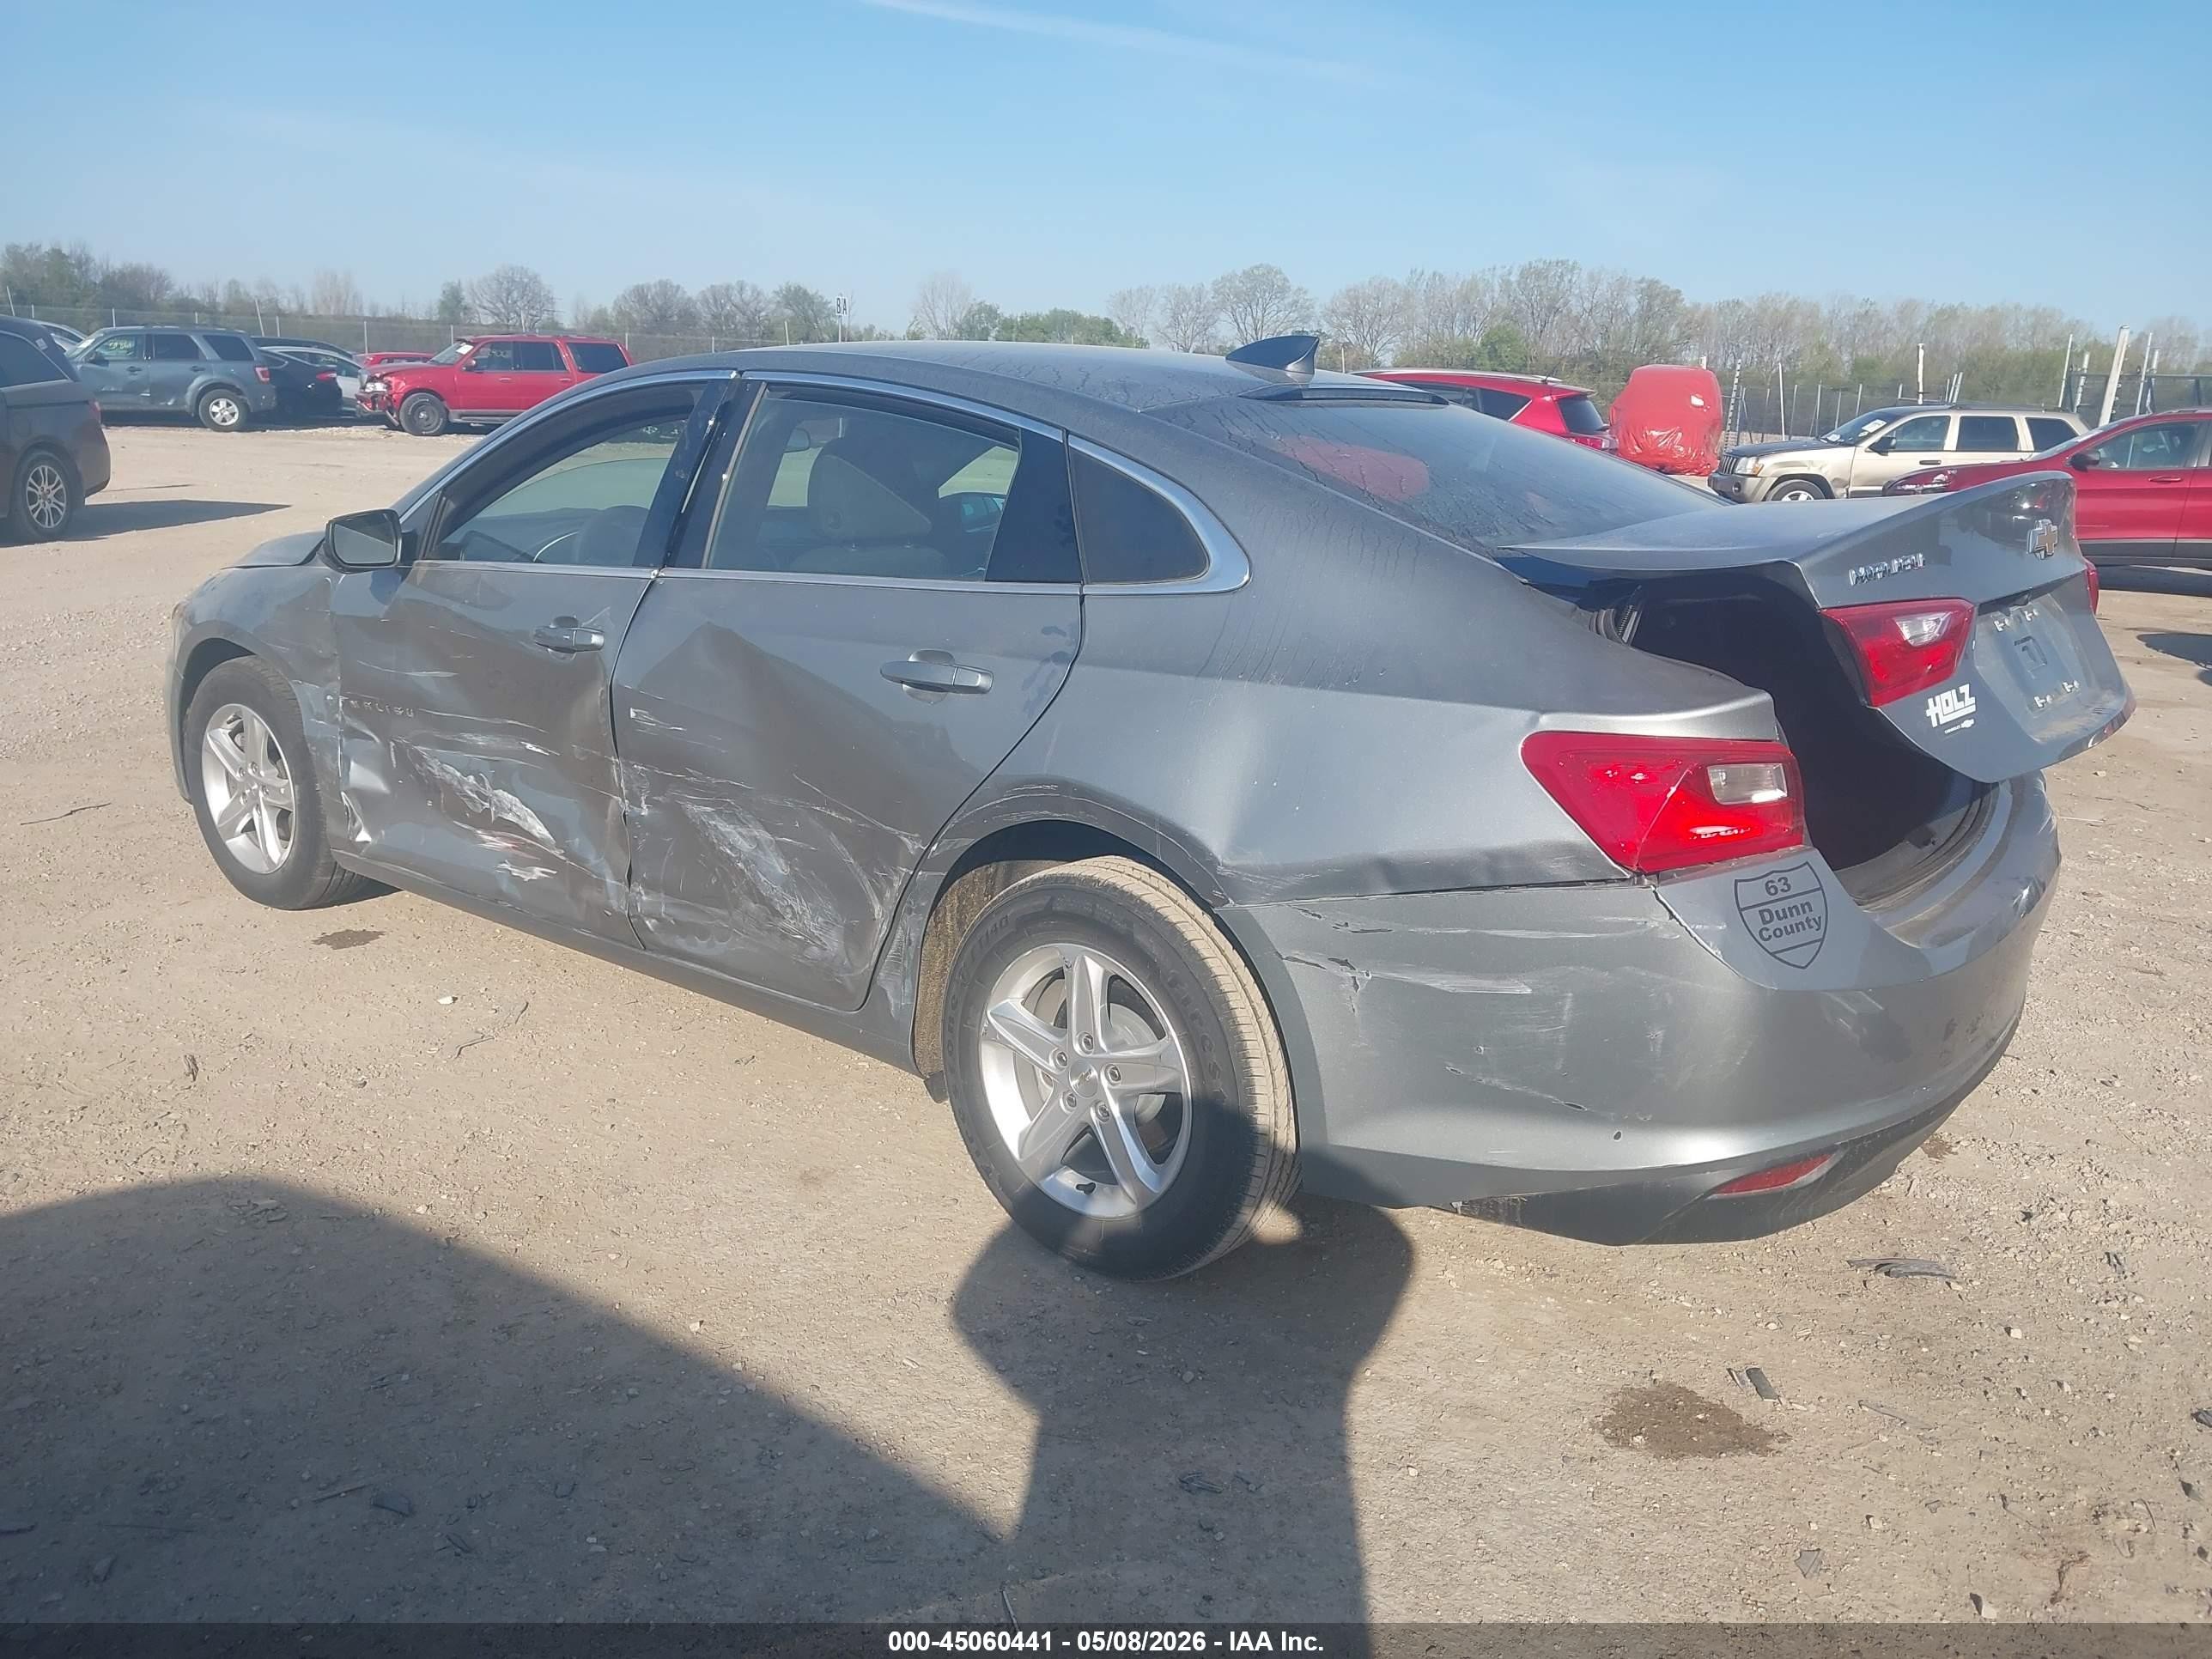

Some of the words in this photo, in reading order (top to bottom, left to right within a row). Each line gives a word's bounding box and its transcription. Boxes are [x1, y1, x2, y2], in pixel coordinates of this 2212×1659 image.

[1926, 684, 1976, 727] HOLZ
[1765, 877, 1792, 896] 63
[1759, 901, 1813, 926] Dunn
[1759, 915, 1822, 942] County
